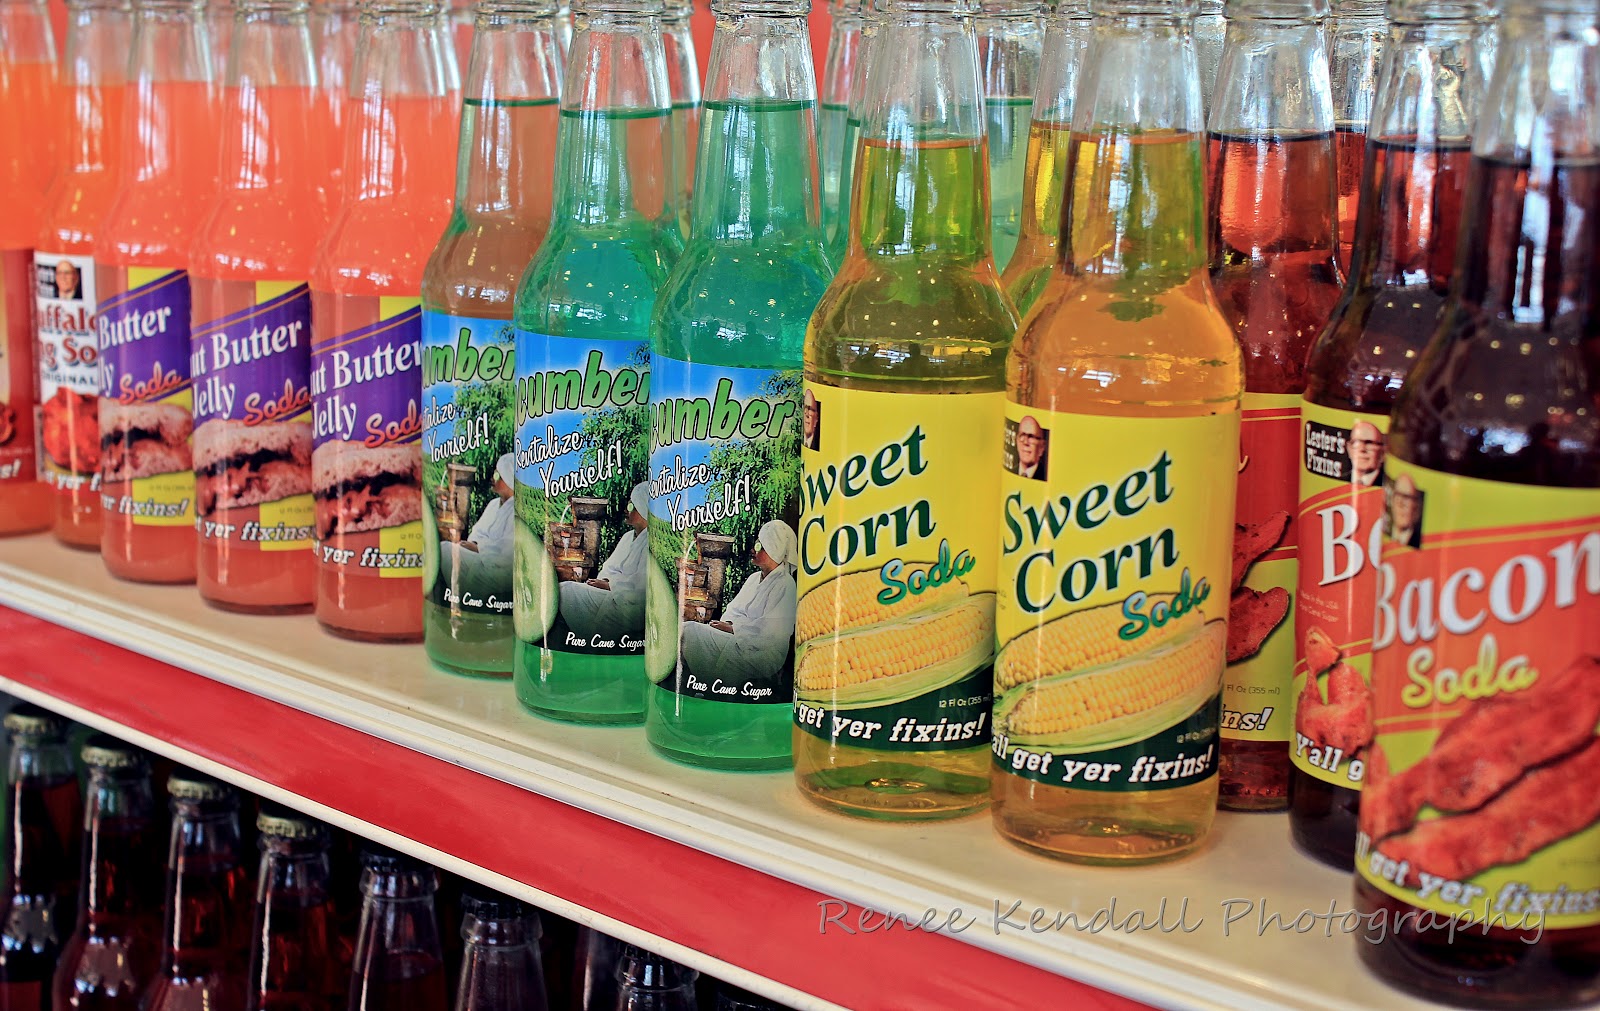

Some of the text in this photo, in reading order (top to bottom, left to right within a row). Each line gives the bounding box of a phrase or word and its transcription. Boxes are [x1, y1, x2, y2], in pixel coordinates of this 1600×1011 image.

[99, 305, 171, 350] Butter
[210, 320, 302, 372] Butter
[119, 361, 182, 405] Soda
[192, 376, 236, 420] Jelly
[242, 378, 310, 427] Soda
[312, 395, 357, 441] Jelly
[364, 398, 421, 448] Sod
[428, 412, 490, 464] Yourself!
[1306, 423, 1345, 455] Lester's
[515, 425, 584, 473] Revitalize
[538, 440, 623, 499] Yourself!
[1306, 449, 1342, 478] Fixins
[119, 495, 190, 517] fixins!
[667, 474, 751, 532] Yourself!
[1003, 450, 1175, 557] Sweet
[204, 520, 237, 539] yer
[801, 499, 936, 576] Corn
[323, 544, 356, 565] yer
[877, 538, 976, 605] Soda
[1016, 528, 1180, 613] Corn
[462, 592, 484, 608] Cane
[486, 595, 514, 613] Sugar
[1118, 567, 1211, 641] Soda
[1373, 531, 1600, 651] Bacon
[565, 631, 587, 646] Pure
[590, 633, 616, 648] Cane
[687, 674, 708, 692] Pure
[711, 679, 738, 696] Cane
[740, 681, 773, 702] Sugar
[1402, 633, 1539, 709] Soda
[798, 702, 987, 743] get yer fixins!
[1012, 748, 1053, 775] get
[1062, 759, 1121, 783] yer
[1128, 744, 1213, 783] fixins!
[1295, 732, 1343, 773] Y'all
[1369, 851, 1410, 887] get
[1417, 872, 1486, 905] yer
